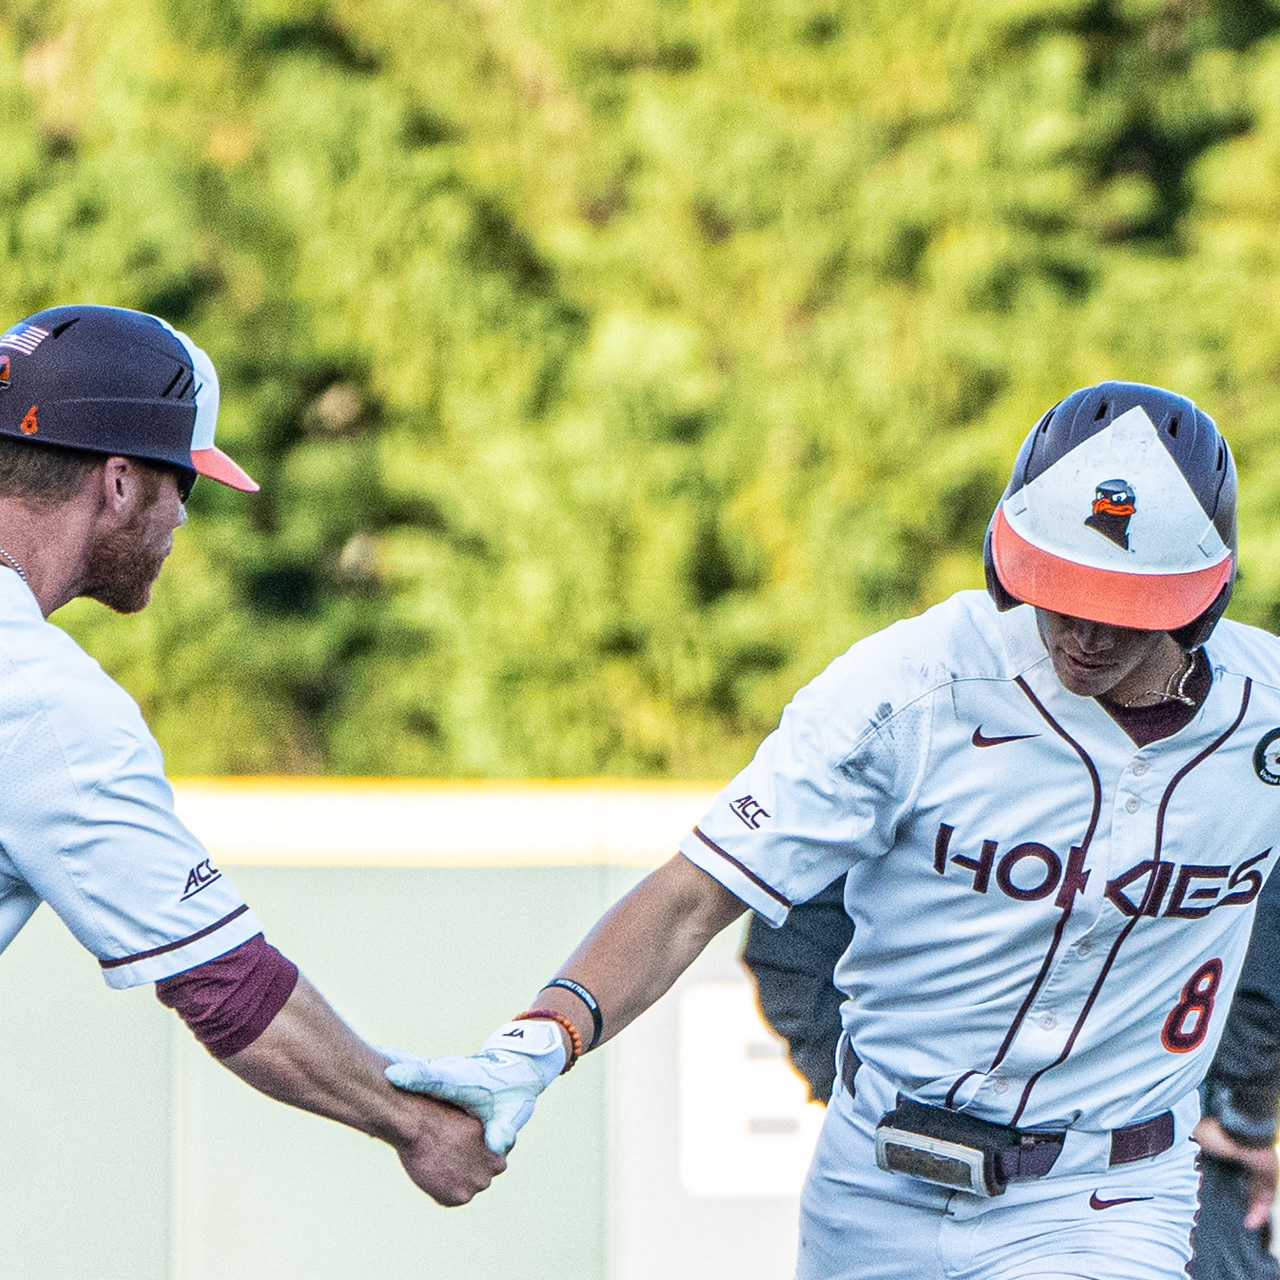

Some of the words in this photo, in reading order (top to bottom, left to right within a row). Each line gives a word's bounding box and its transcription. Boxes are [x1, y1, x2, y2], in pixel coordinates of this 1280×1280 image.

[21, 405, 38, 435] 6
[733, 795, 771, 828] ACC
[183, 858, 219, 895] ACC
[933, 823, 1274, 919] HOKIES
[1161, 957, 1223, 1054] 8
